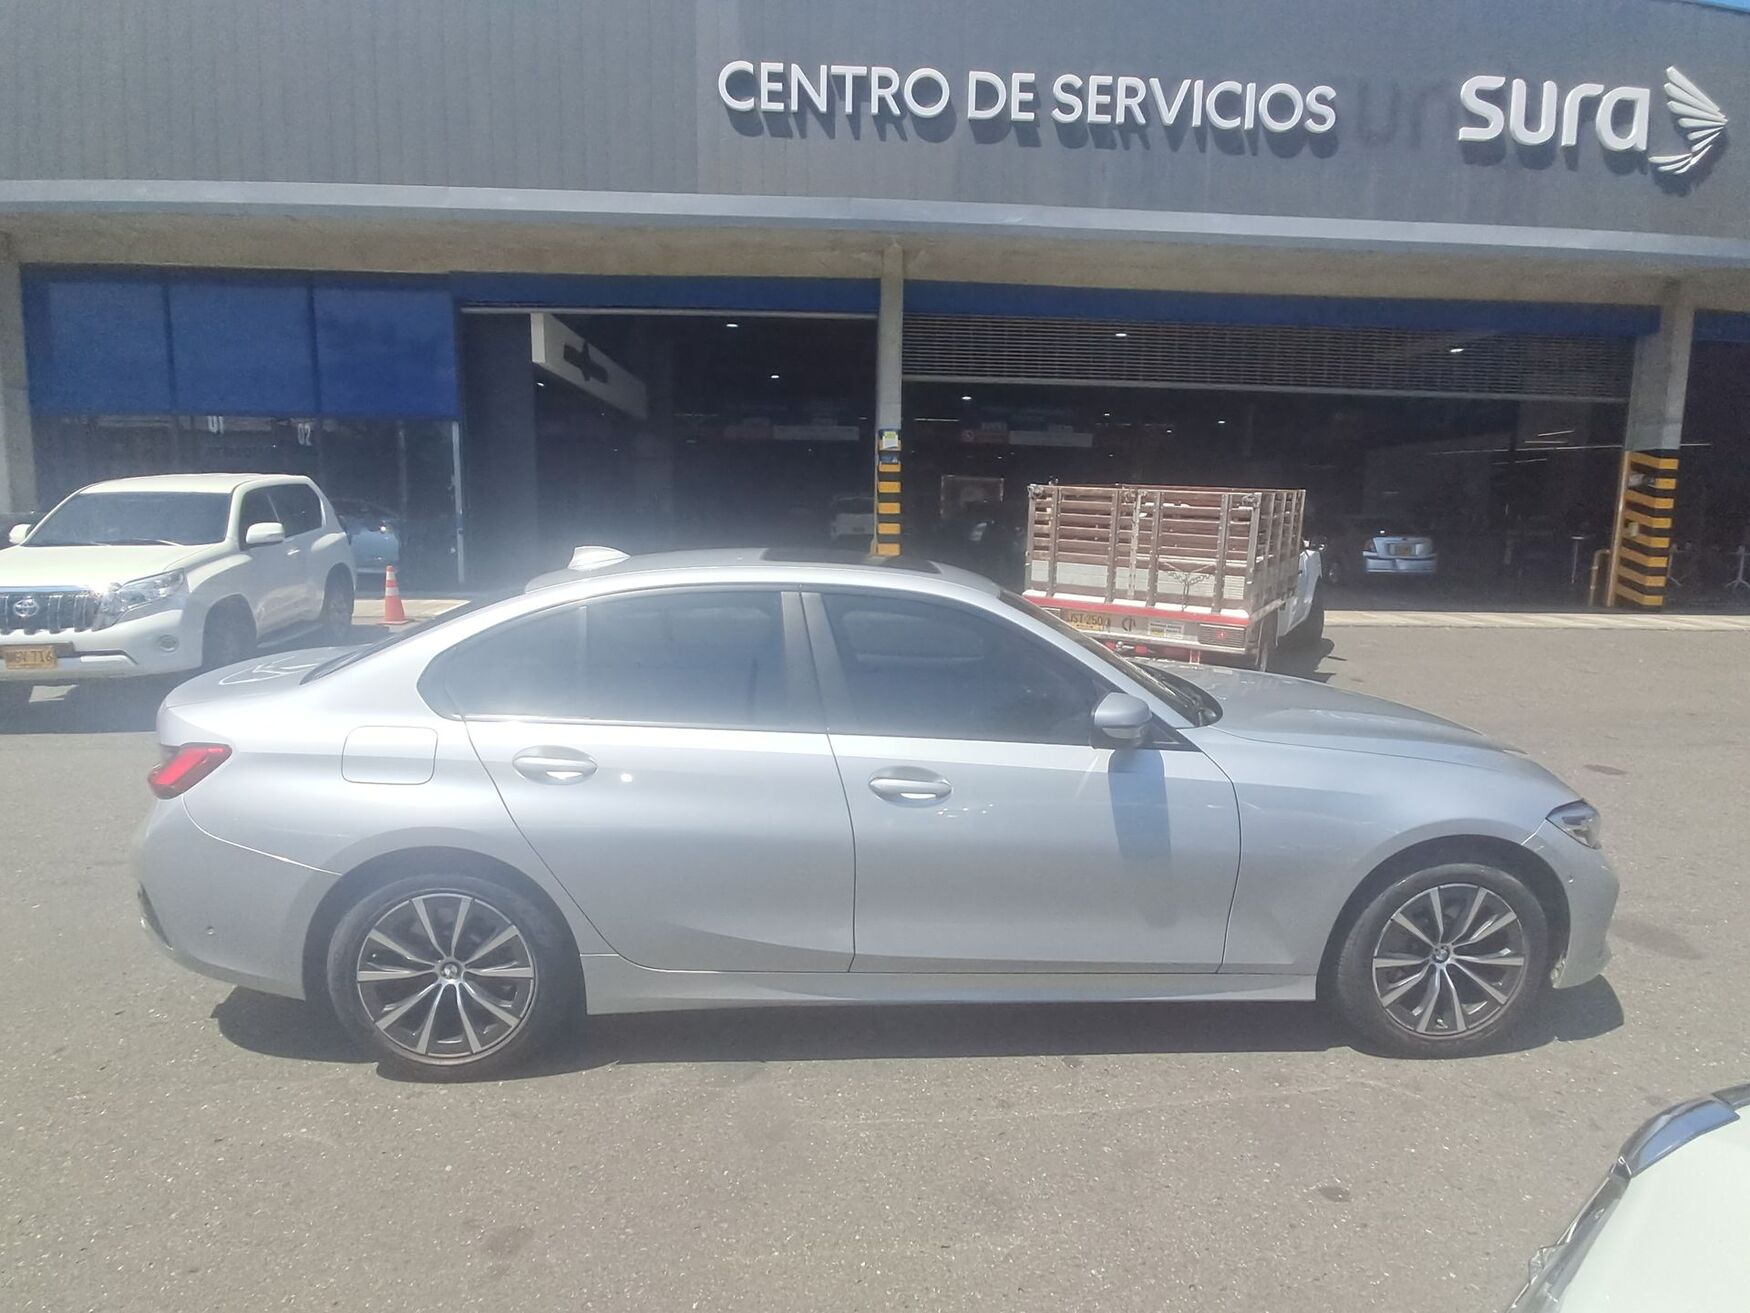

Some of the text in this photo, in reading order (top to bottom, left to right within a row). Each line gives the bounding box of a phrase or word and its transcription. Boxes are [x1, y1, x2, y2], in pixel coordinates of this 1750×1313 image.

[718, 60, 1337, 133] CENTRO DE SERVICIOS
[1458, 75, 1650, 151] sura
